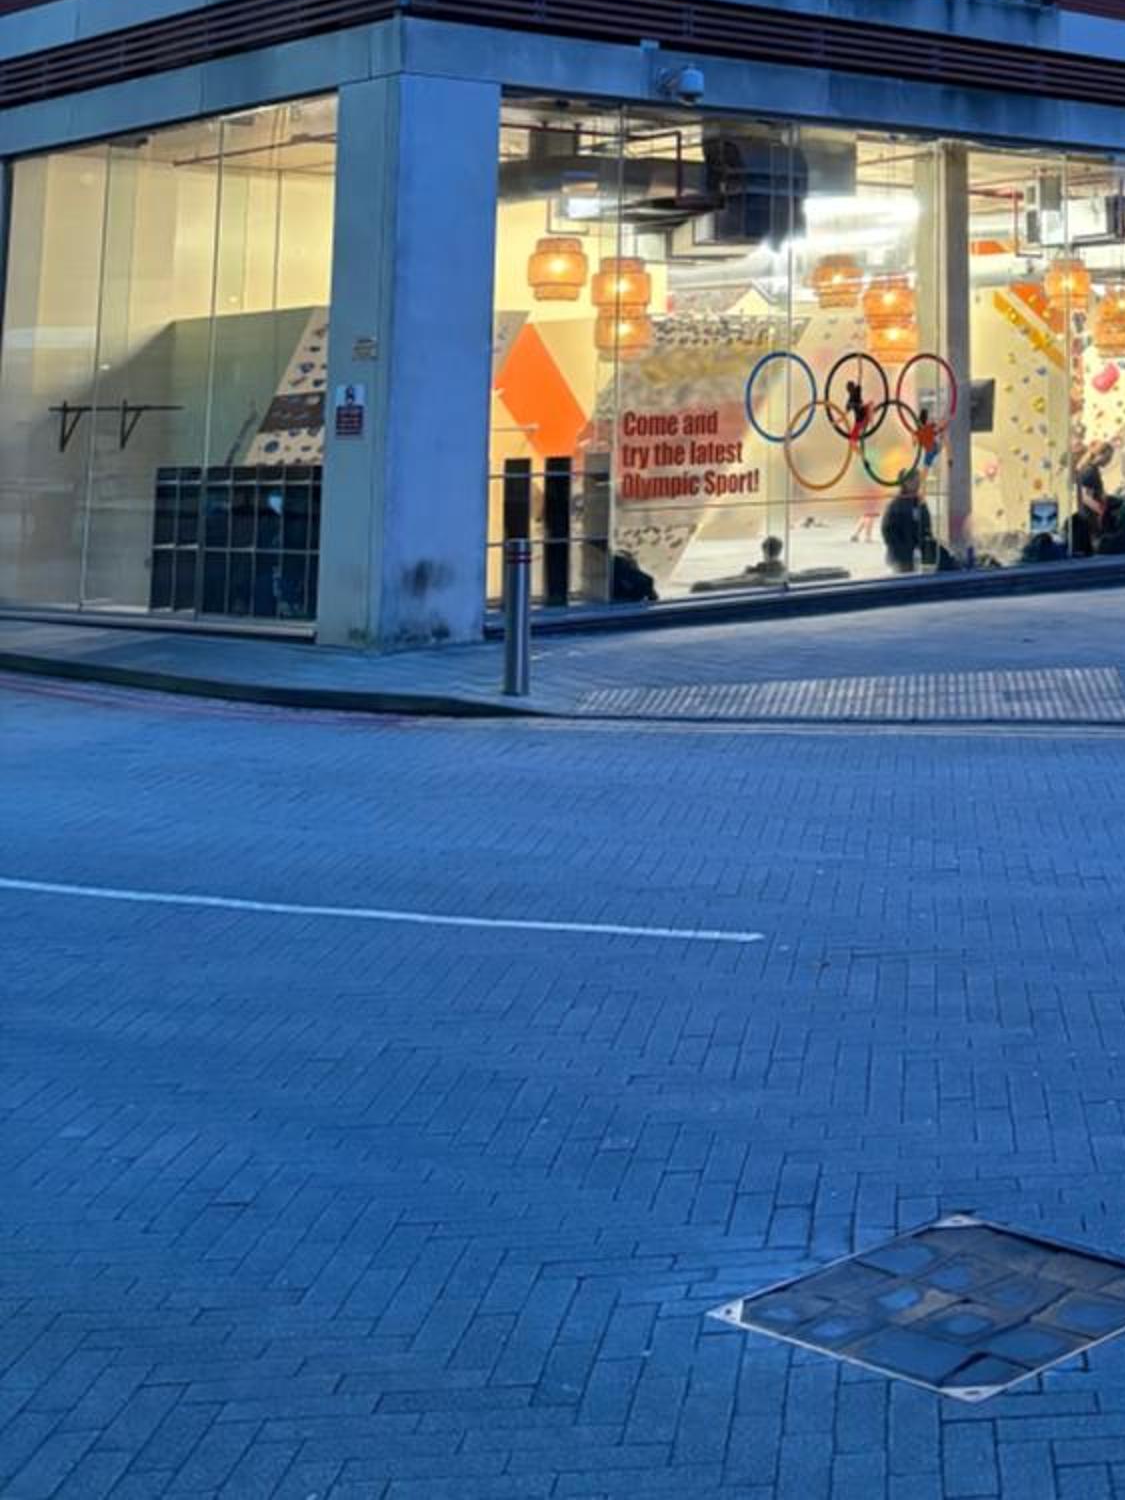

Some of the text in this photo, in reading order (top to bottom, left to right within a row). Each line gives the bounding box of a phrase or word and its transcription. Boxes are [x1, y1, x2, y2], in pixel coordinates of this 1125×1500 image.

[623, 410, 718, 436] Come and
[622, 441, 743, 470] try the latest
[622, 467, 760, 500] Olympic Sport!
